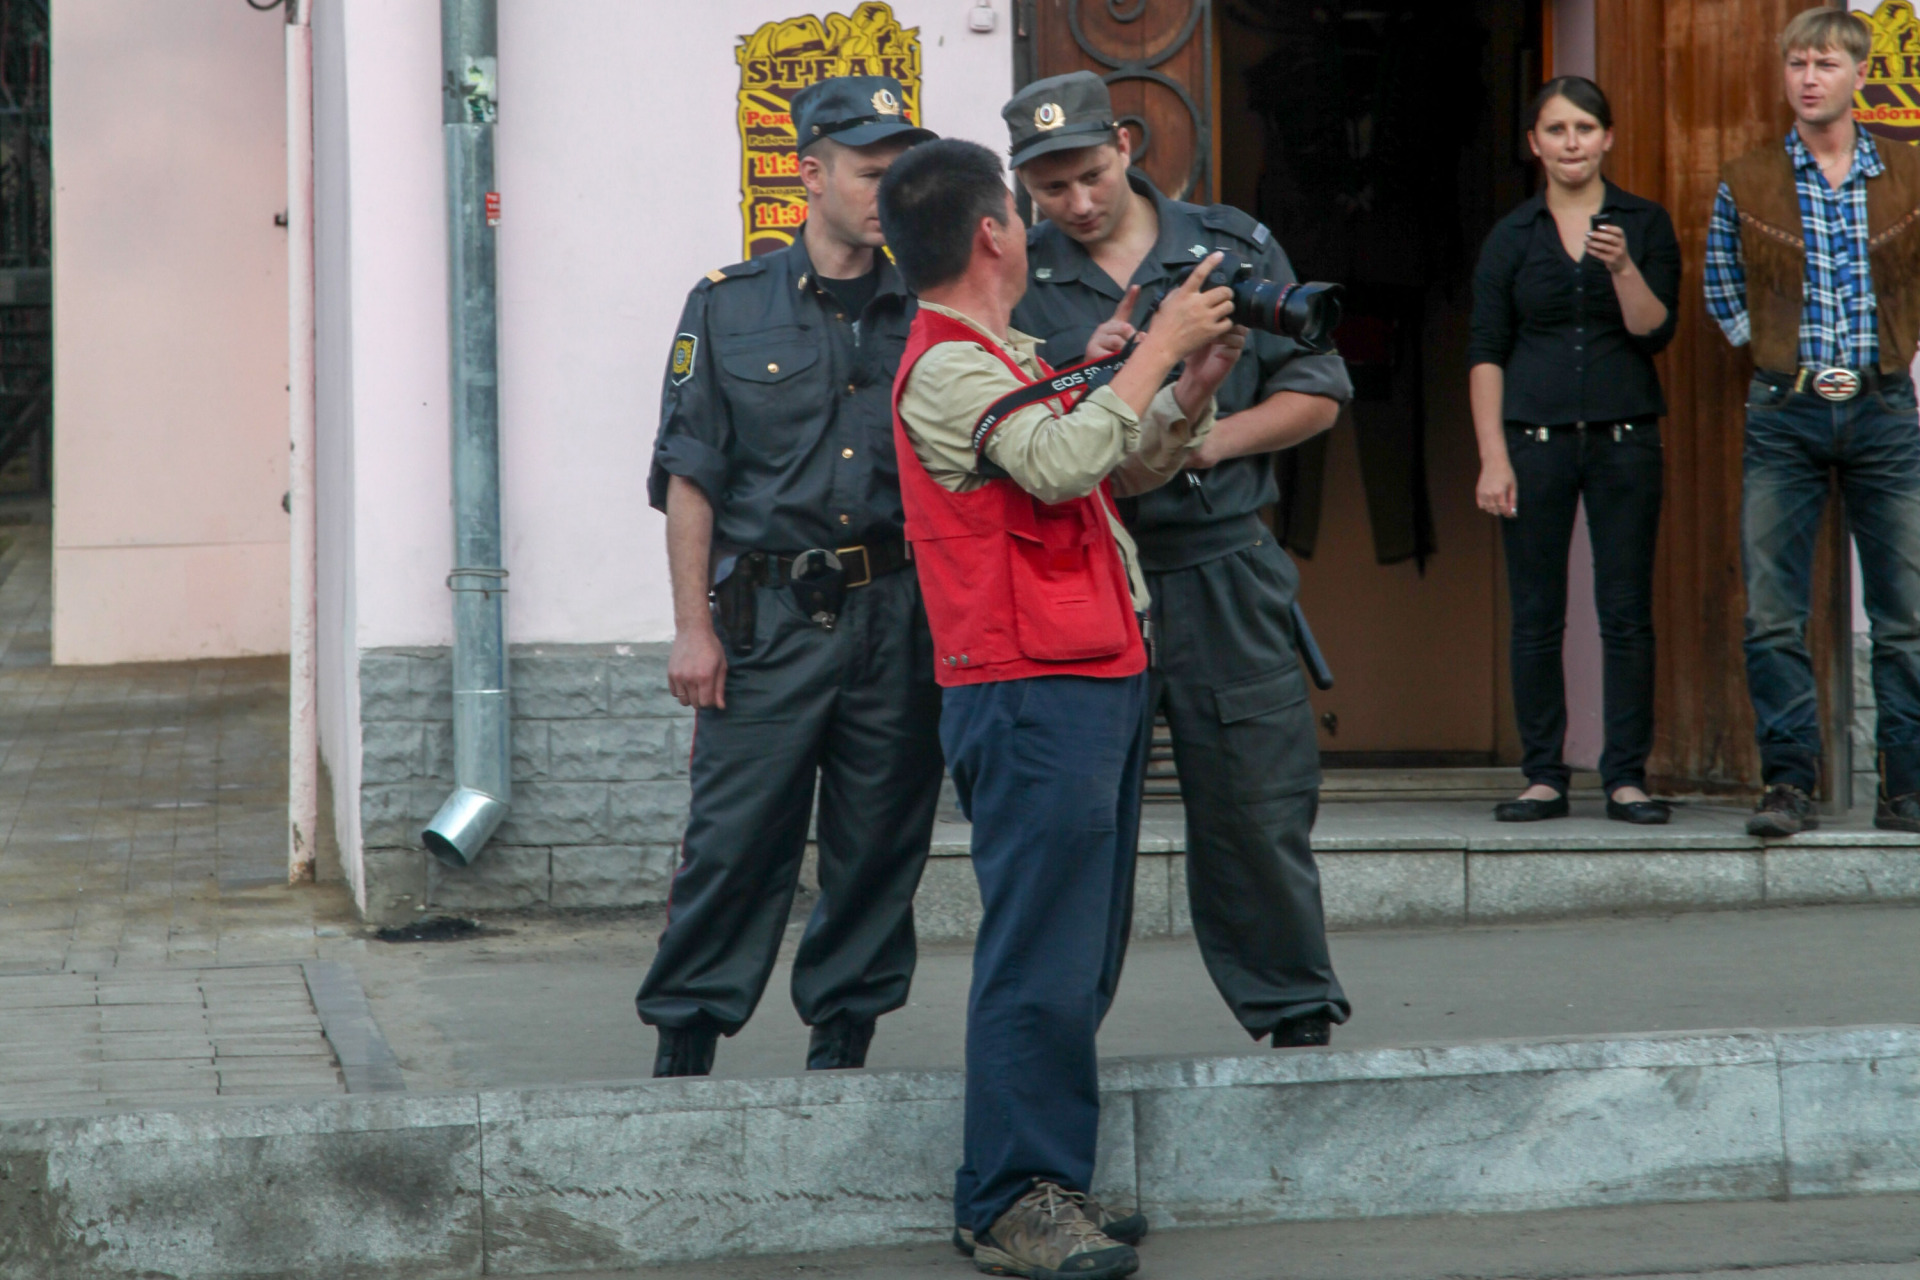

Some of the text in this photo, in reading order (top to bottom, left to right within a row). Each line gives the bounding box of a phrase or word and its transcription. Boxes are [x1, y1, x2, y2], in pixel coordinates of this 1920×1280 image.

[747, 57, 909, 83] STEAK
[746, 110, 792, 126] Реж
[757, 153, 800, 175] 11:3
[1051, 372, 1086, 391] EOS
